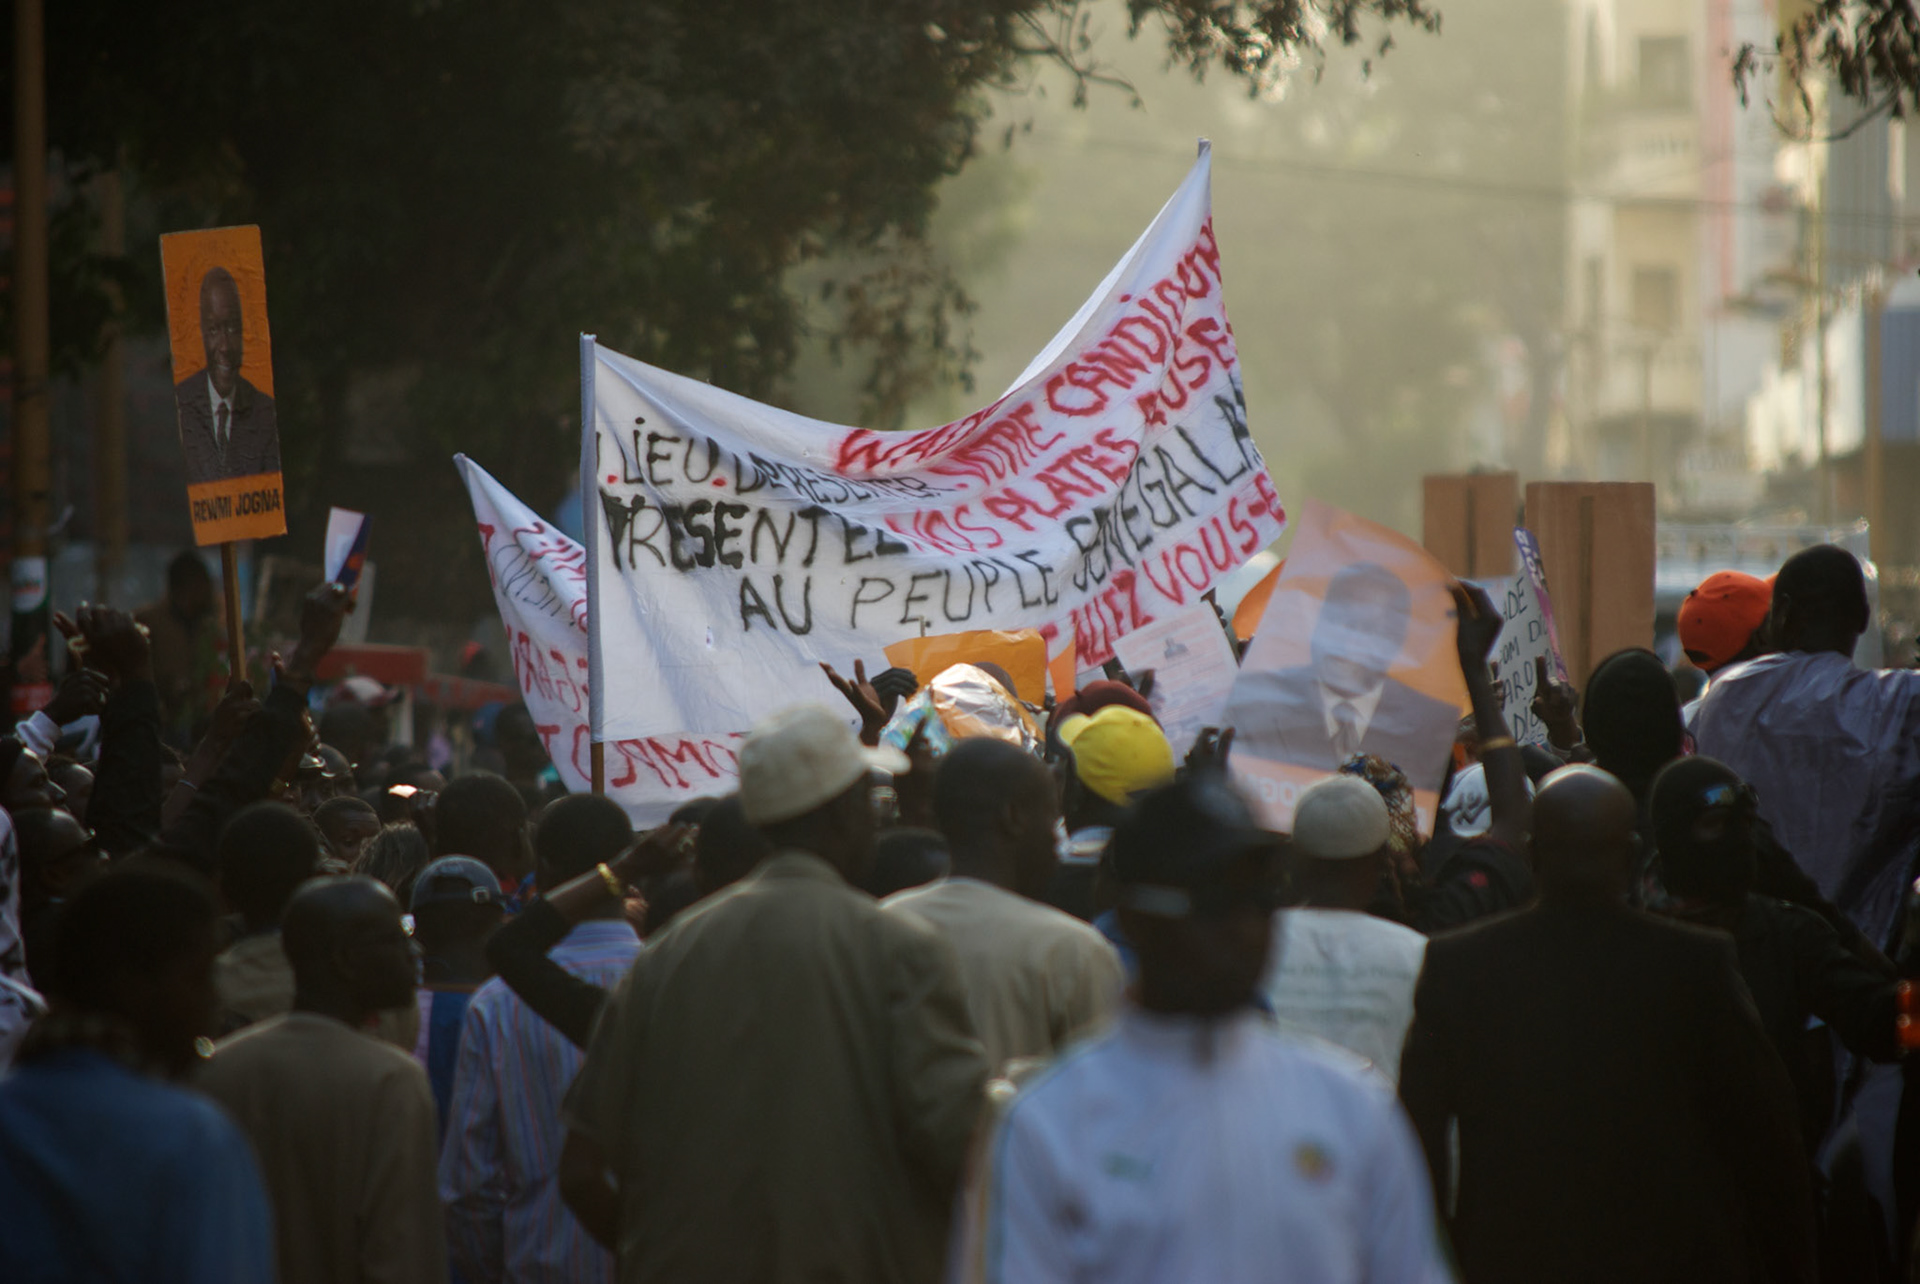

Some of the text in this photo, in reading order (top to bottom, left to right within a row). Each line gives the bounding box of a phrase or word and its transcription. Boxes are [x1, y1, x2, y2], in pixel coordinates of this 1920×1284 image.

[193, 488, 280, 523] REWMI JOGNA
[739, 574, 812, 636] AU
[851, 550, 1059, 630] PEUPLE
